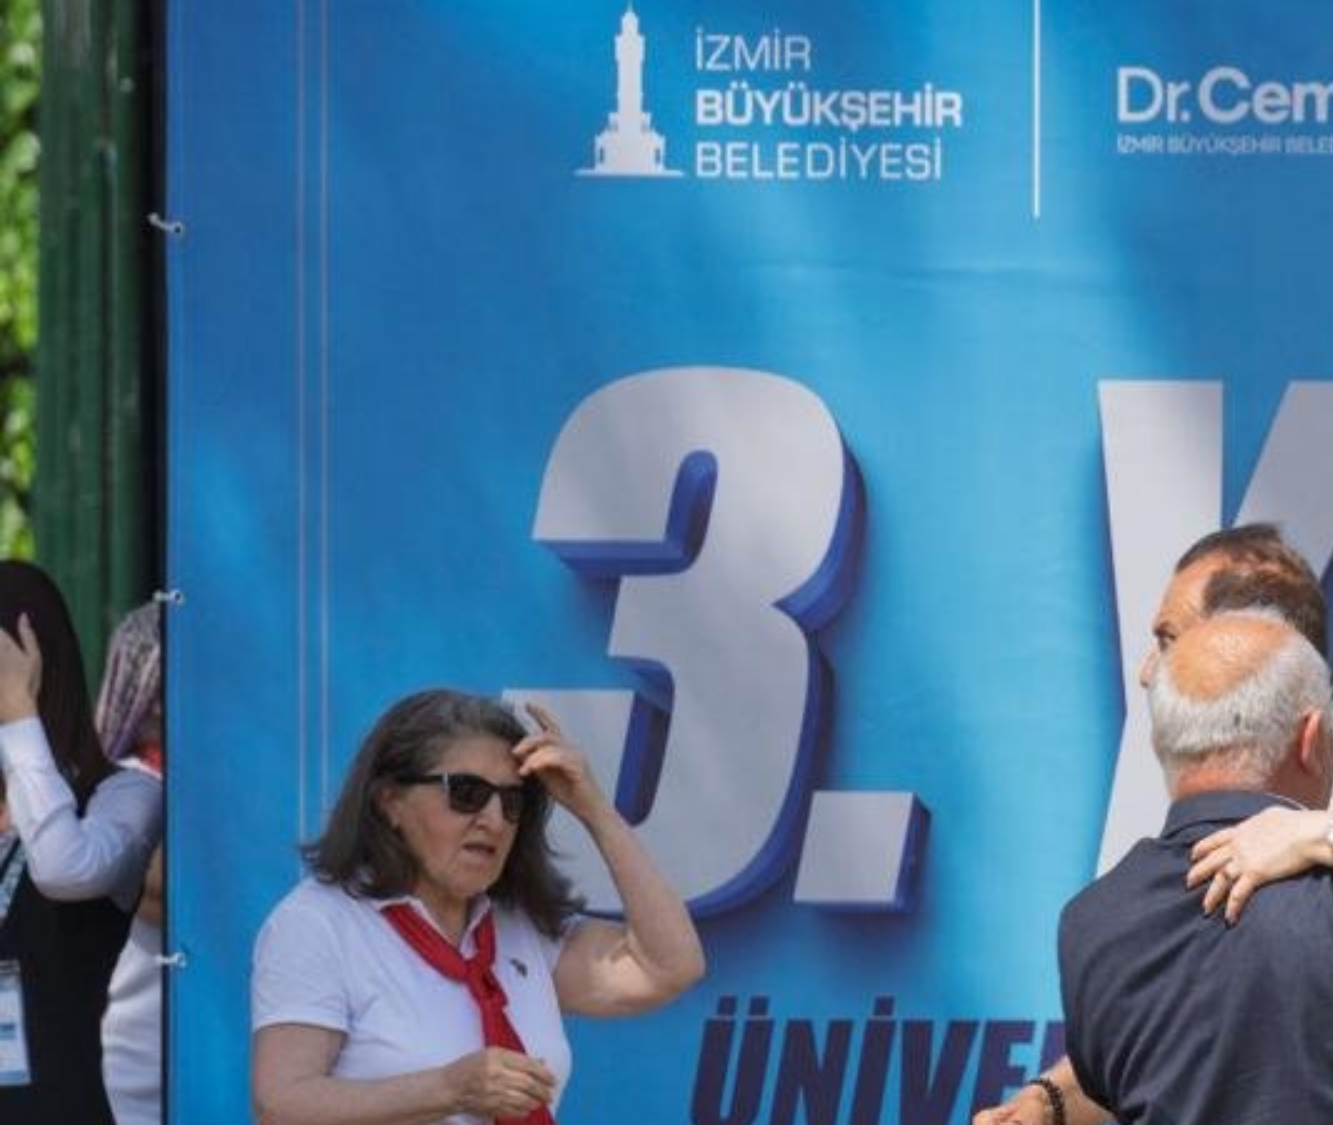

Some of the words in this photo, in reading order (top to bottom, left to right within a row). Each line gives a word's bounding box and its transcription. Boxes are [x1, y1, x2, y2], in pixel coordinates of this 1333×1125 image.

[695, 26, 812, 72] İZMİR
[695, 80, 963, 132] BÜYÜKŞEHİR
[695, 137, 942, 181] BELEDİYESİ
